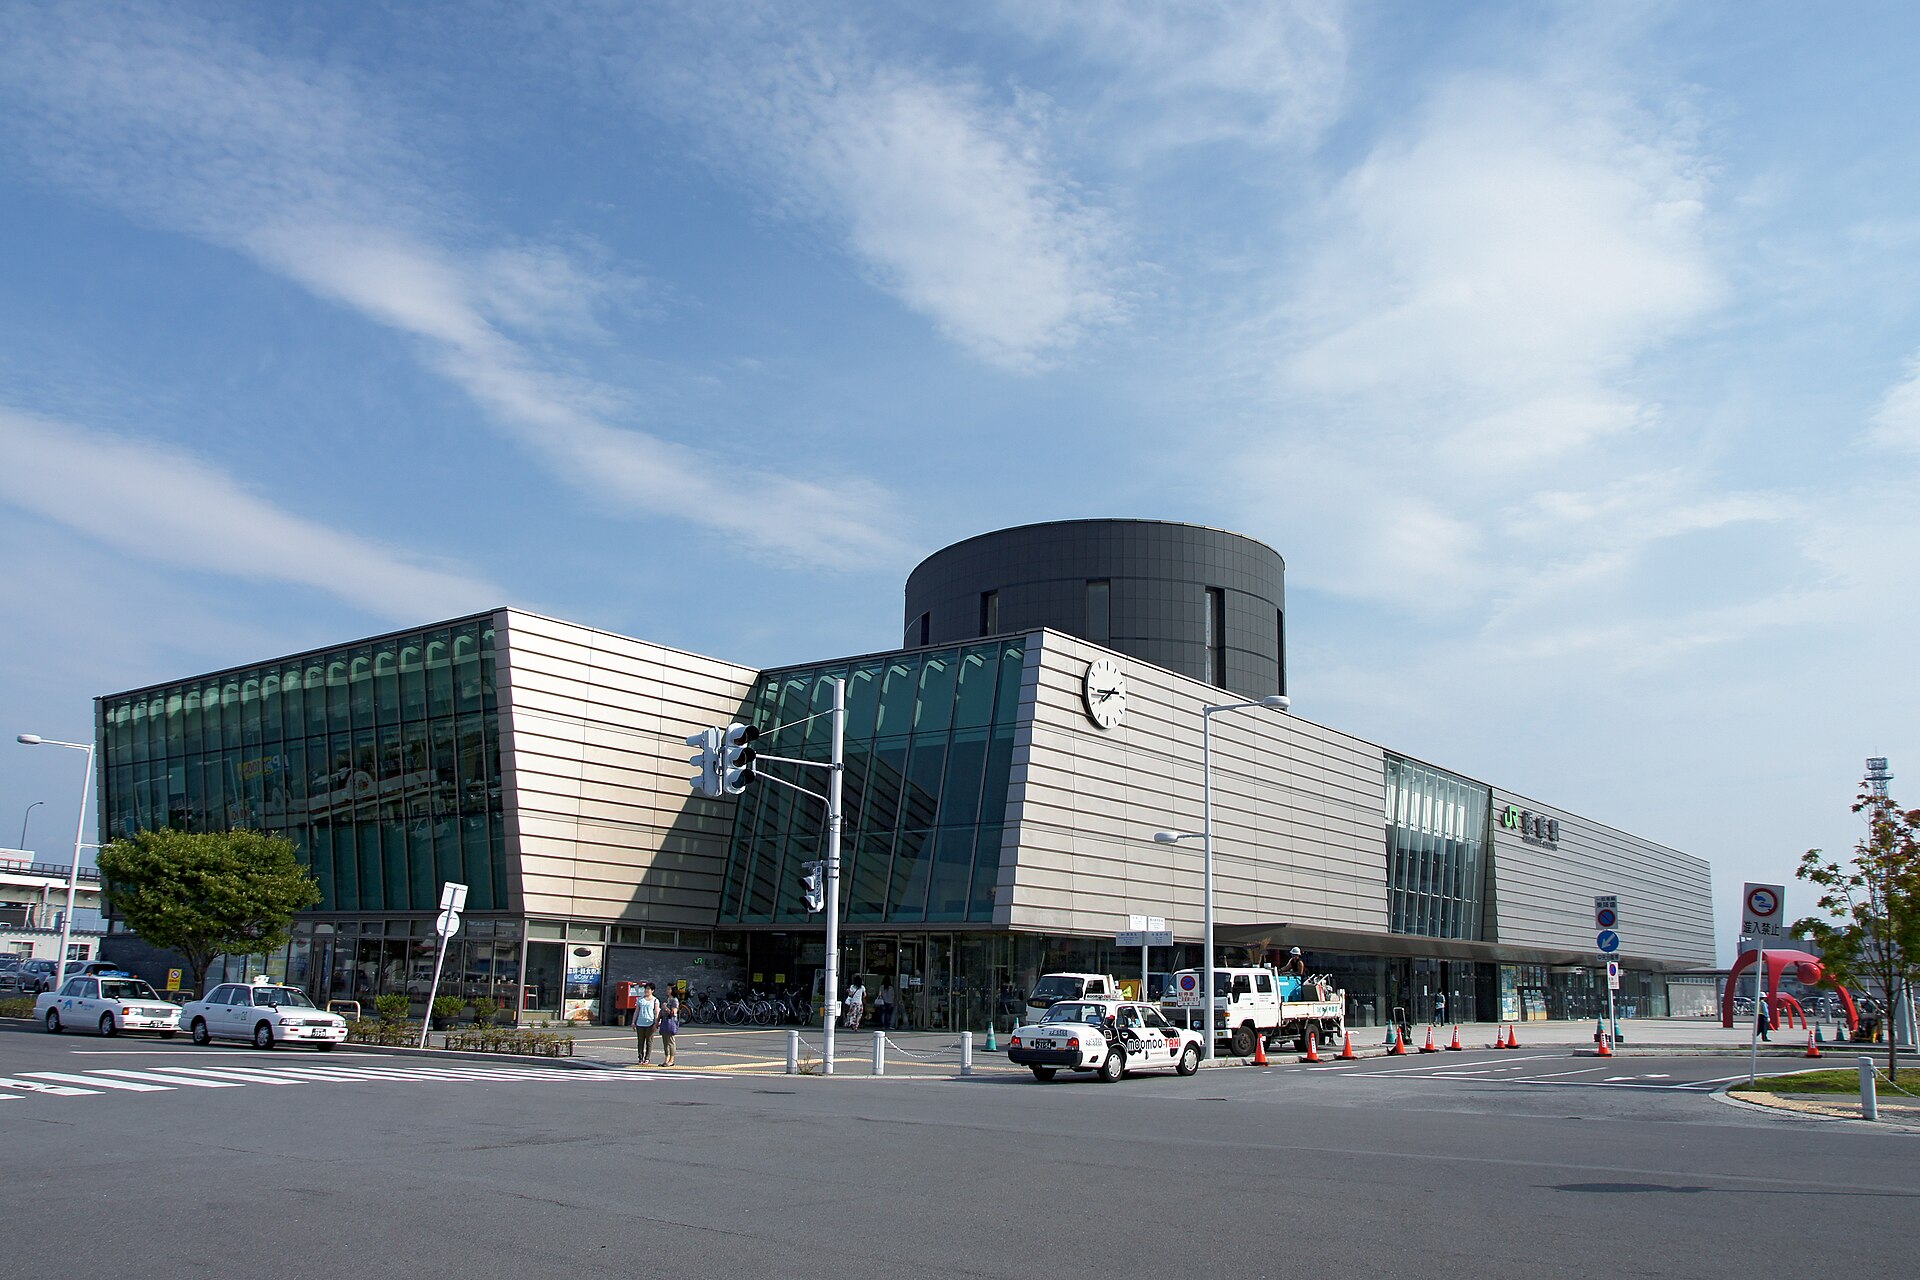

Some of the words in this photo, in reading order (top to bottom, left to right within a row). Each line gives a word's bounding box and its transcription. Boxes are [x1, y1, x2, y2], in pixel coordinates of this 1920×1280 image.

[1502, 805, 1519, 829] JR
[1743, 920, 1780, 937] 進入禁止
[694, 957, 703, 965] JR
